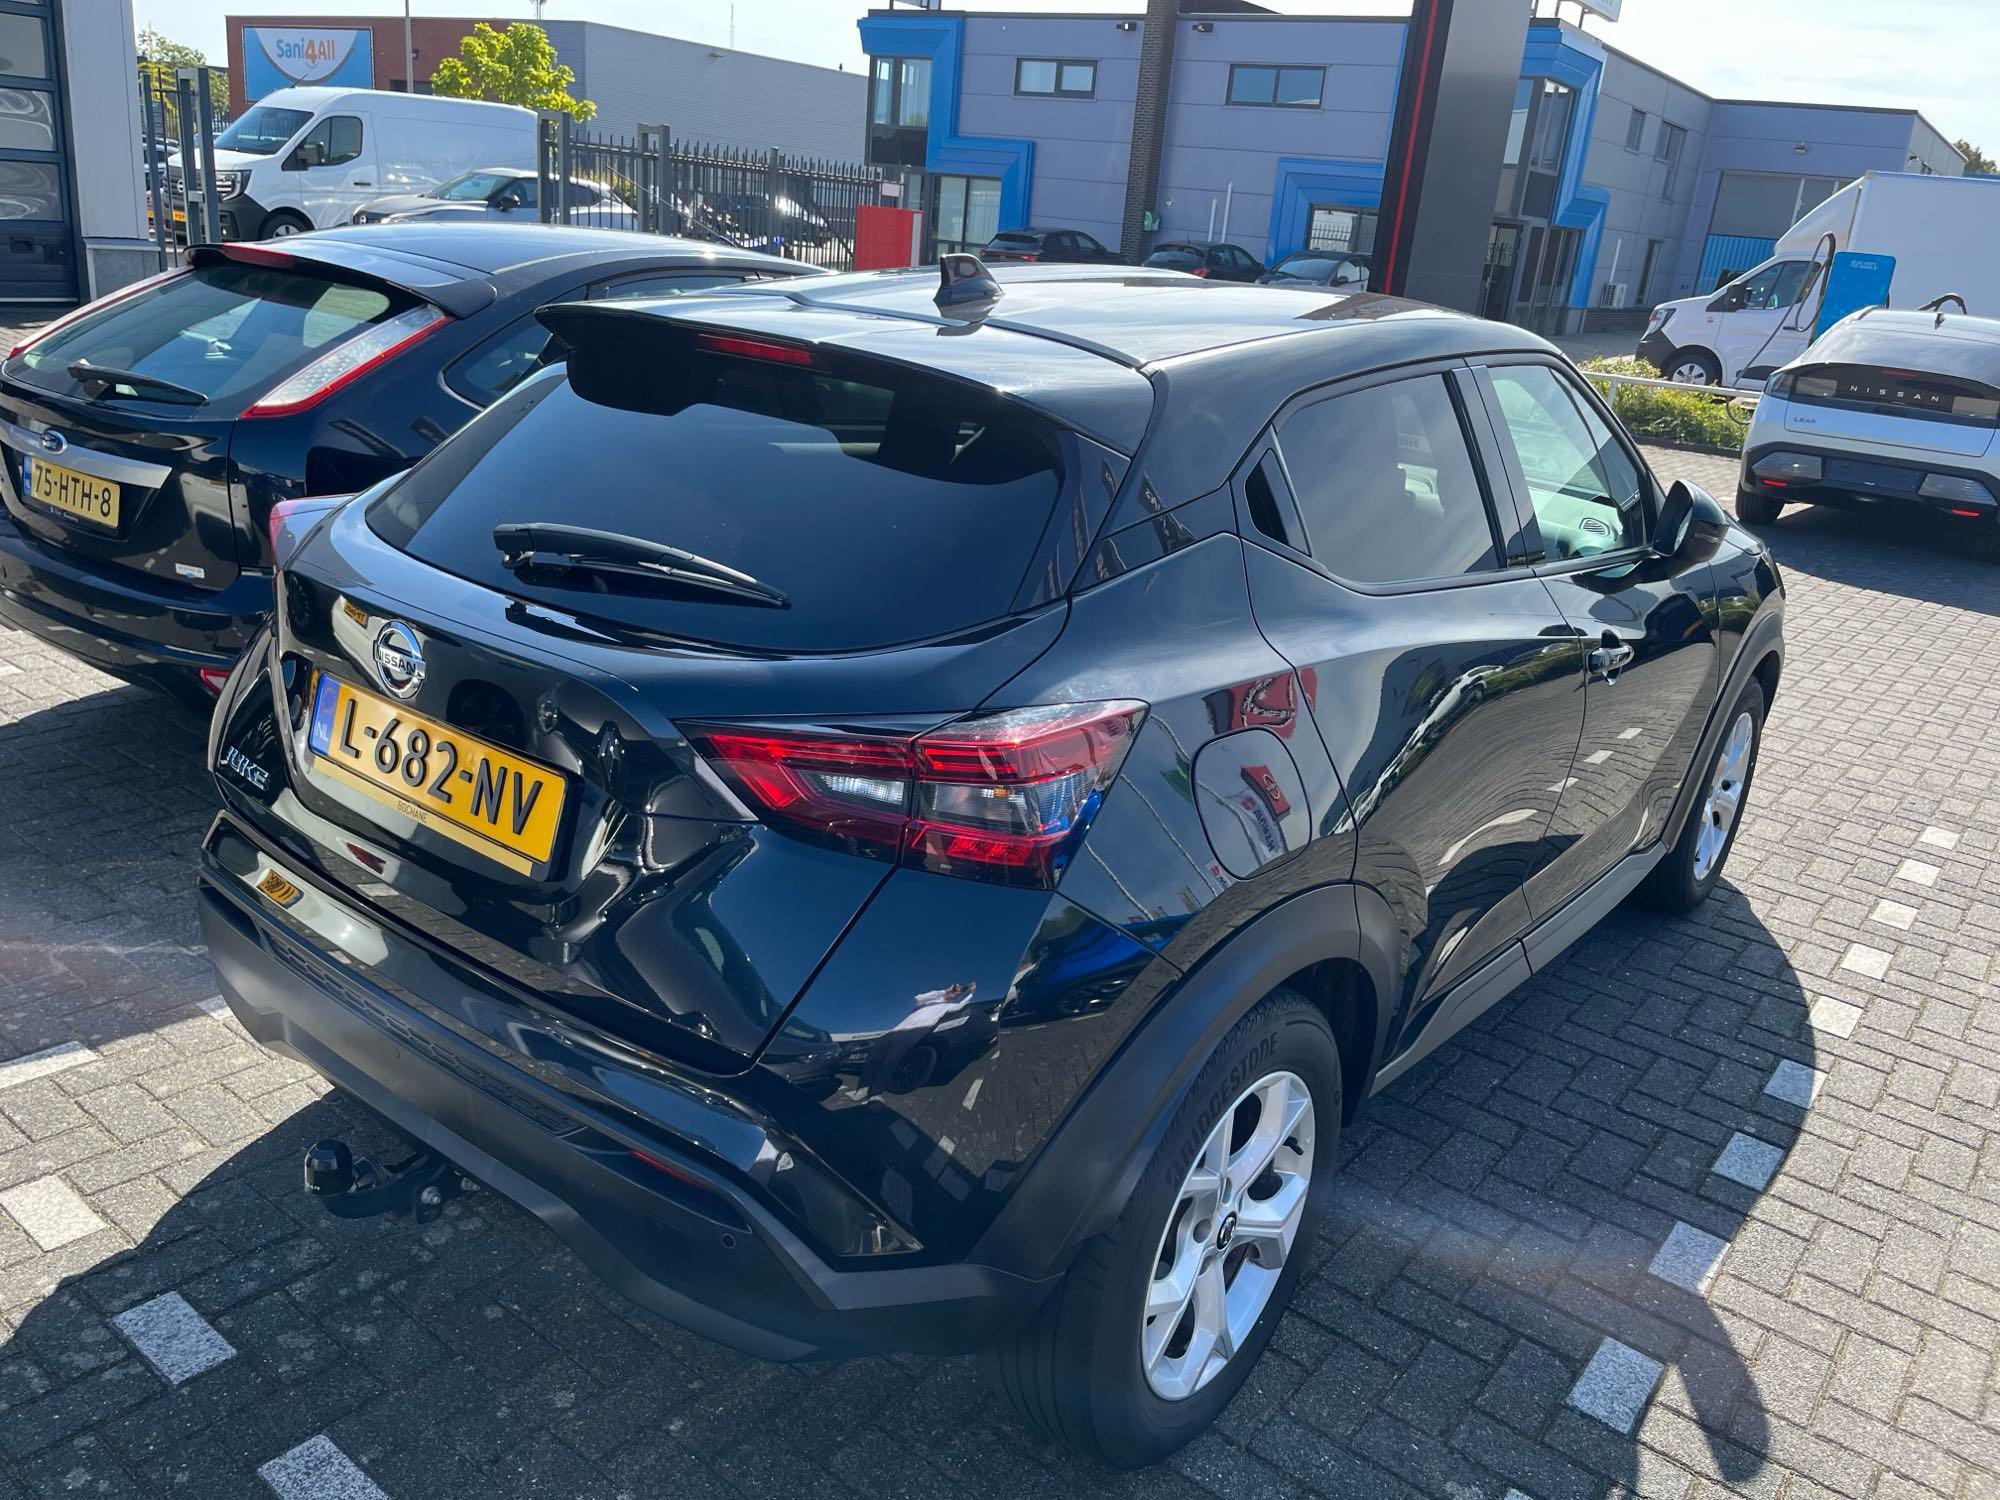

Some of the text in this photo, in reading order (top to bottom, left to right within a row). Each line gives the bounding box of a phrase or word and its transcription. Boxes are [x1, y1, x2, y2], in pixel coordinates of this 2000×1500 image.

[276, 37, 335, 65] Sani4All
[1850, 385, 1940, 403] NISSAN
[1793, 416, 1817, 425] LEAF
[34, 463, 112, 518] 75-HTH-8
[315, 721, 329, 742] NL
[220, 745, 269, 790] JUKE
[339, 698, 543, 836] L-682-NV
[397, 800, 428, 823] BOCHANE
